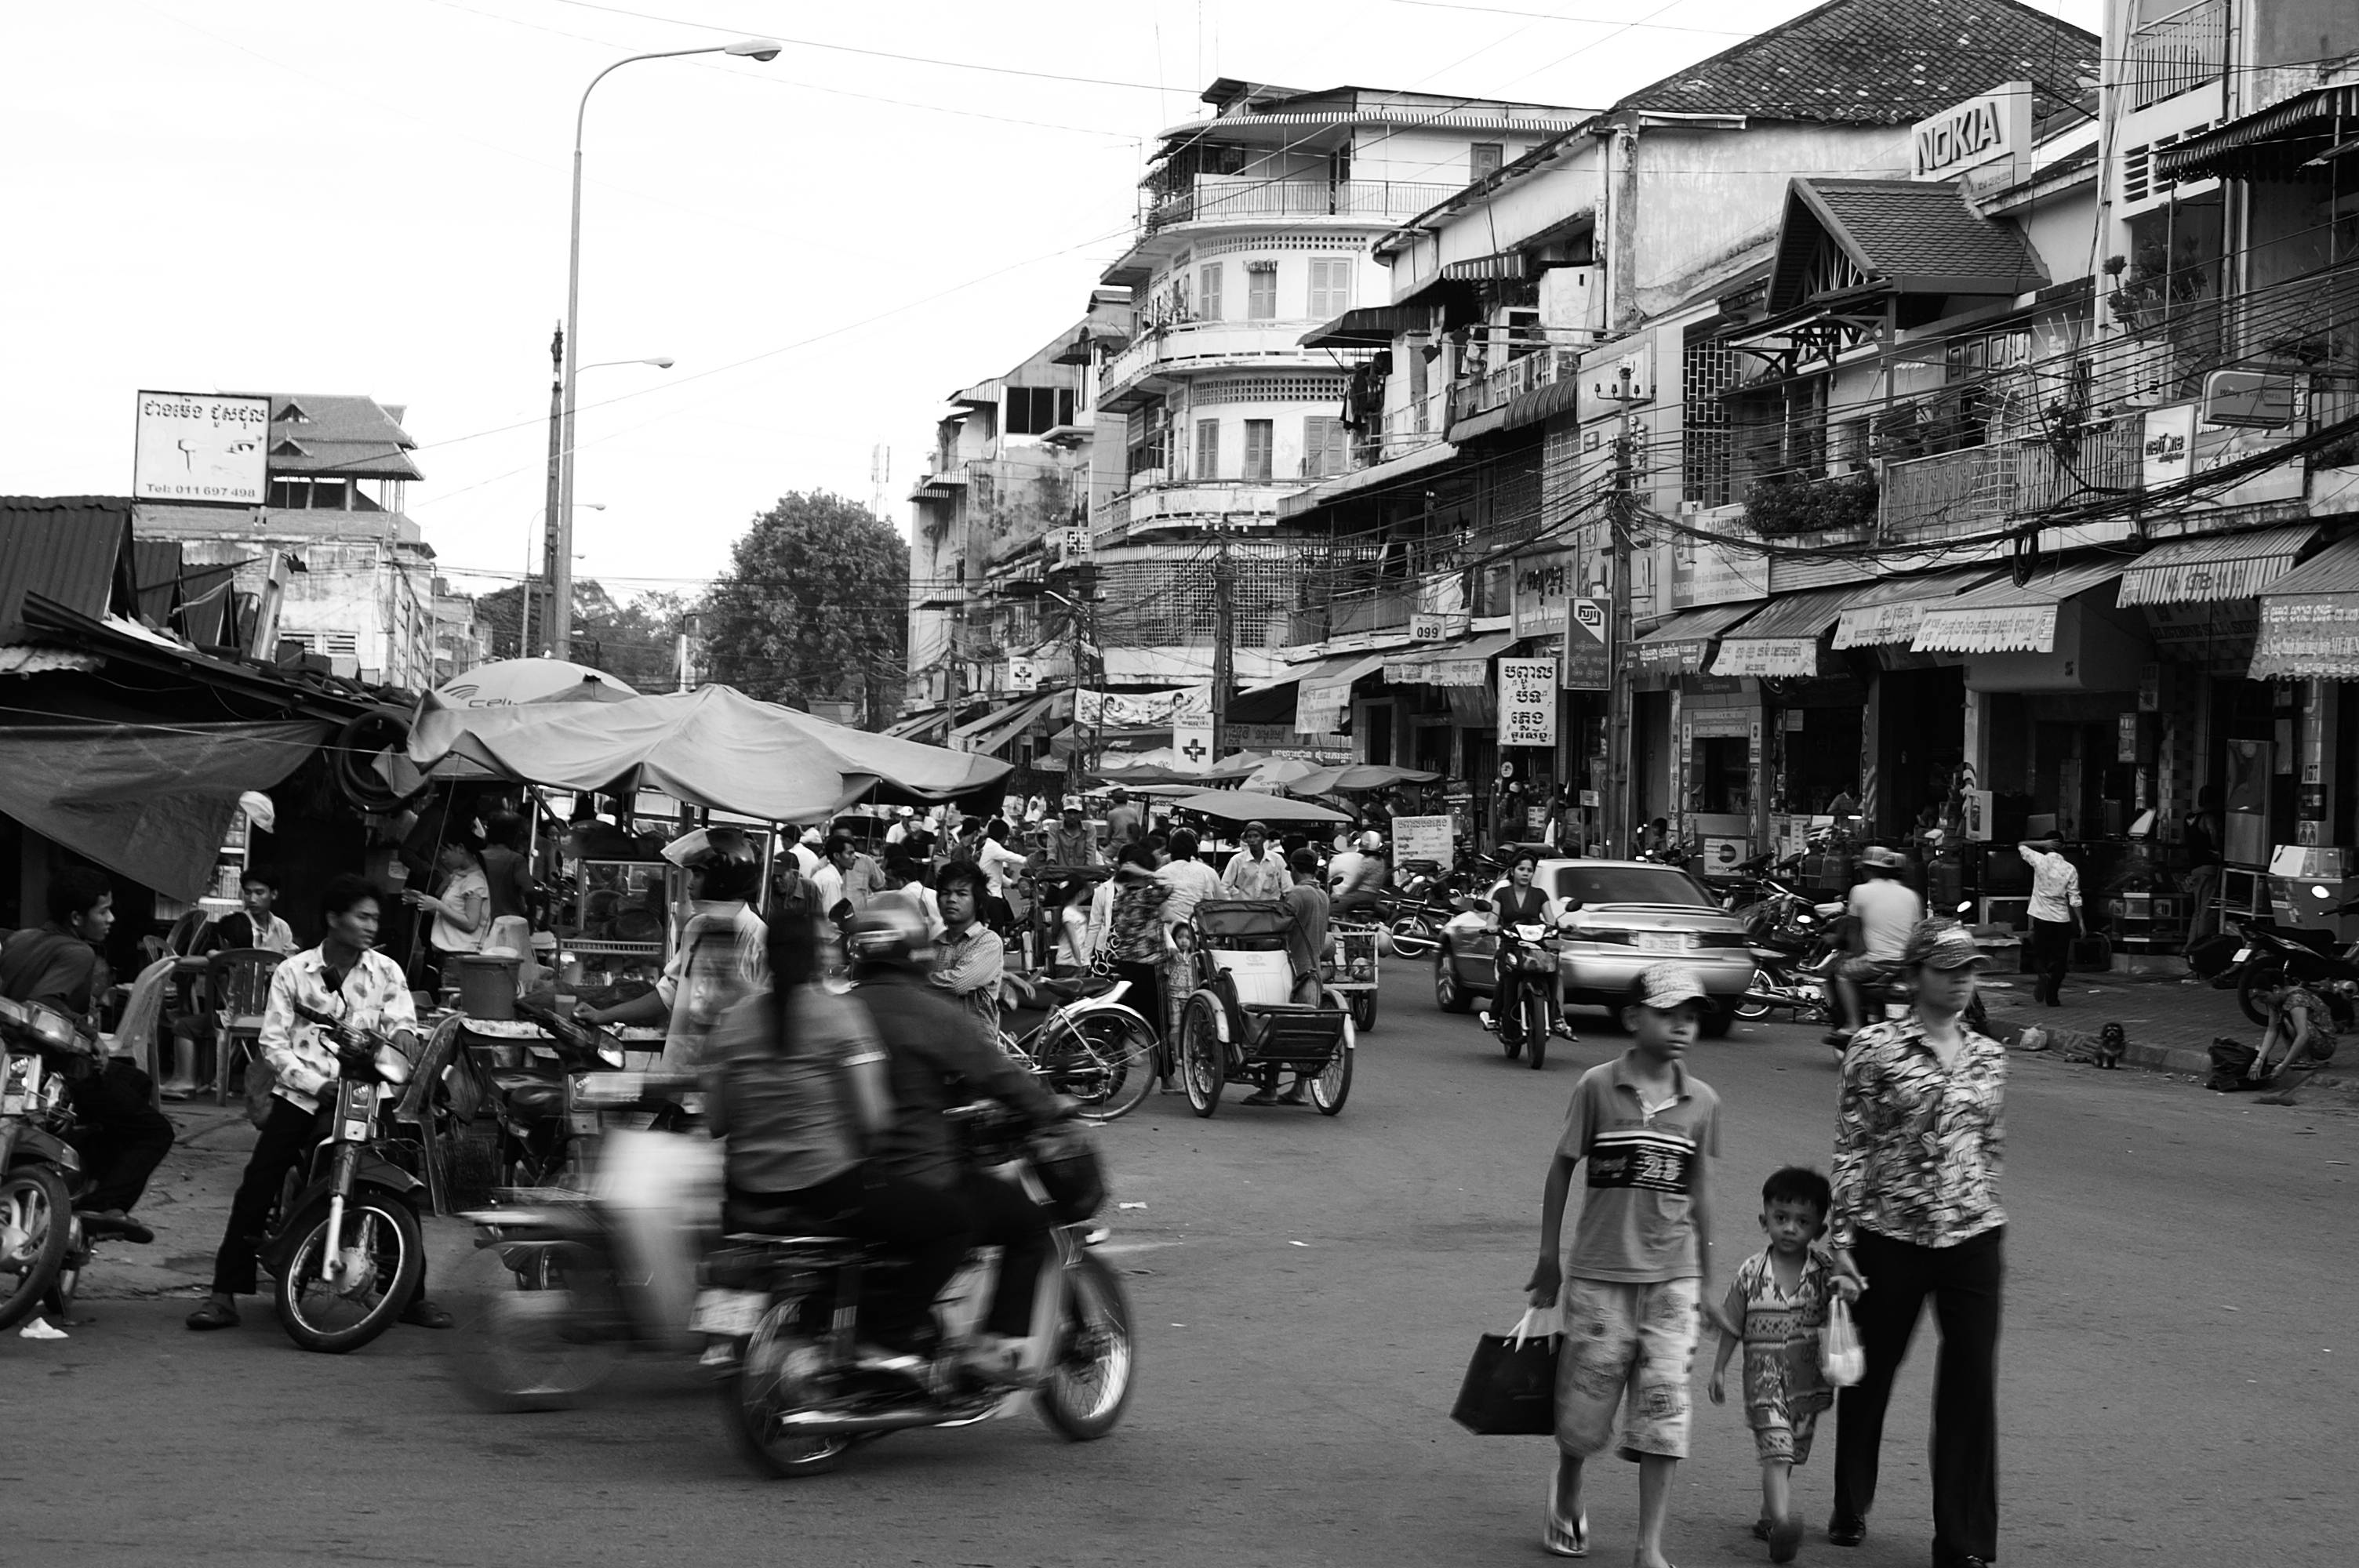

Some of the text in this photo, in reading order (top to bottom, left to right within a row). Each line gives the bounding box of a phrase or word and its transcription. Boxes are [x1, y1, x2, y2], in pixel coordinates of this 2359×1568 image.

[1916, 101, 2001, 176] NOKIA
[147, 483, 256, 498] Tel: 011 697 498
[1416, 626, 1439, 639] 099
